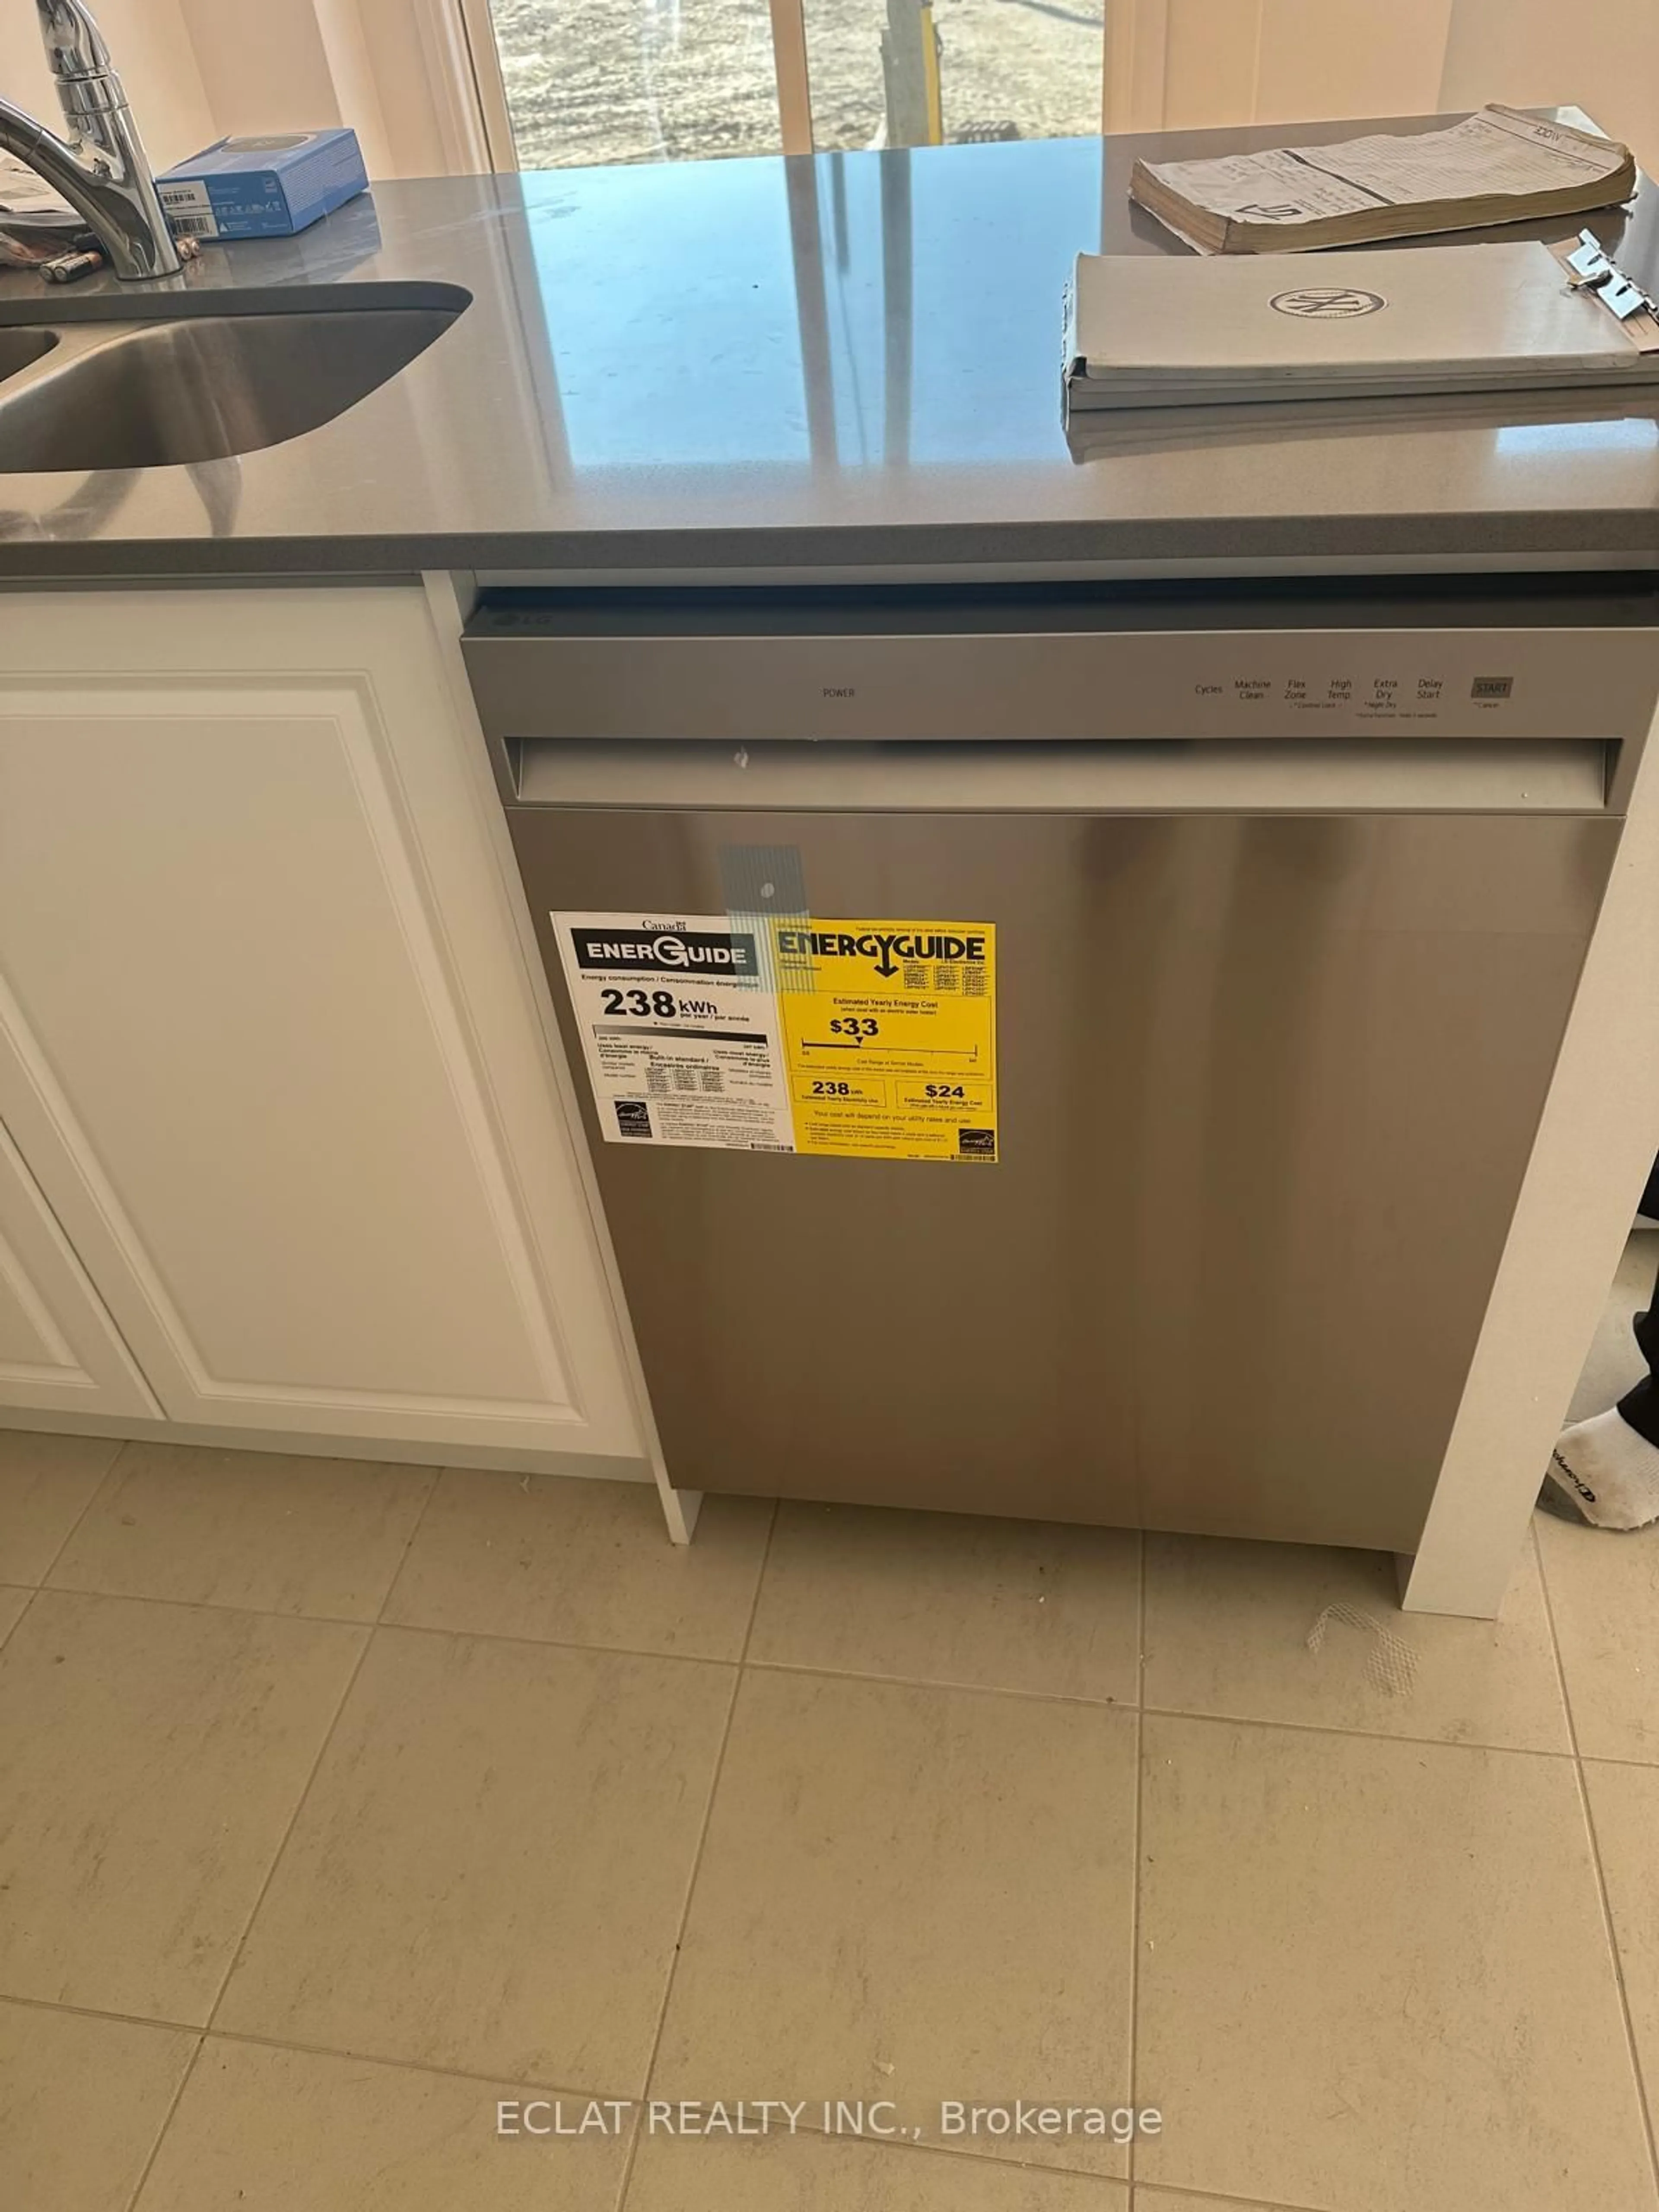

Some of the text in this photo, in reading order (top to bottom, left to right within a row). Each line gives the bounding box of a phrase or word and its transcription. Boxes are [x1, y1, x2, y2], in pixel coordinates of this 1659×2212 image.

[1235, 680, 1271, 689] Machine
[1288, 680, 1306, 688] Flex
[1331, 680, 1352, 690] High
[1373, 679, 1398, 689] Extra
[1418, 679, 1443, 690] Delay
[1477, 683, 1507, 692] START
[823, 688, 855, 698] POWER
[1195, 684, 1223, 696] Cycles
[1328, 690, 1351, 699] Temp
[1376, 690, 1392, 700] Dry
[1417, 690, 1440, 699] Start
[642, 920, 686, 931] Canada
[779, 931, 985, 960] ENERGYGUIDE
[587, 936, 747, 967] ENERGUIDE
[601, 989, 718, 1017] 238 kWh
[871, 998, 892, 1007] Yearly
[893, 1000, 919, 1008] Energy
[830, 1017, 879, 1036] $33
[812, 1081, 849, 1095] 238
[925, 1084, 965, 1098] $24
